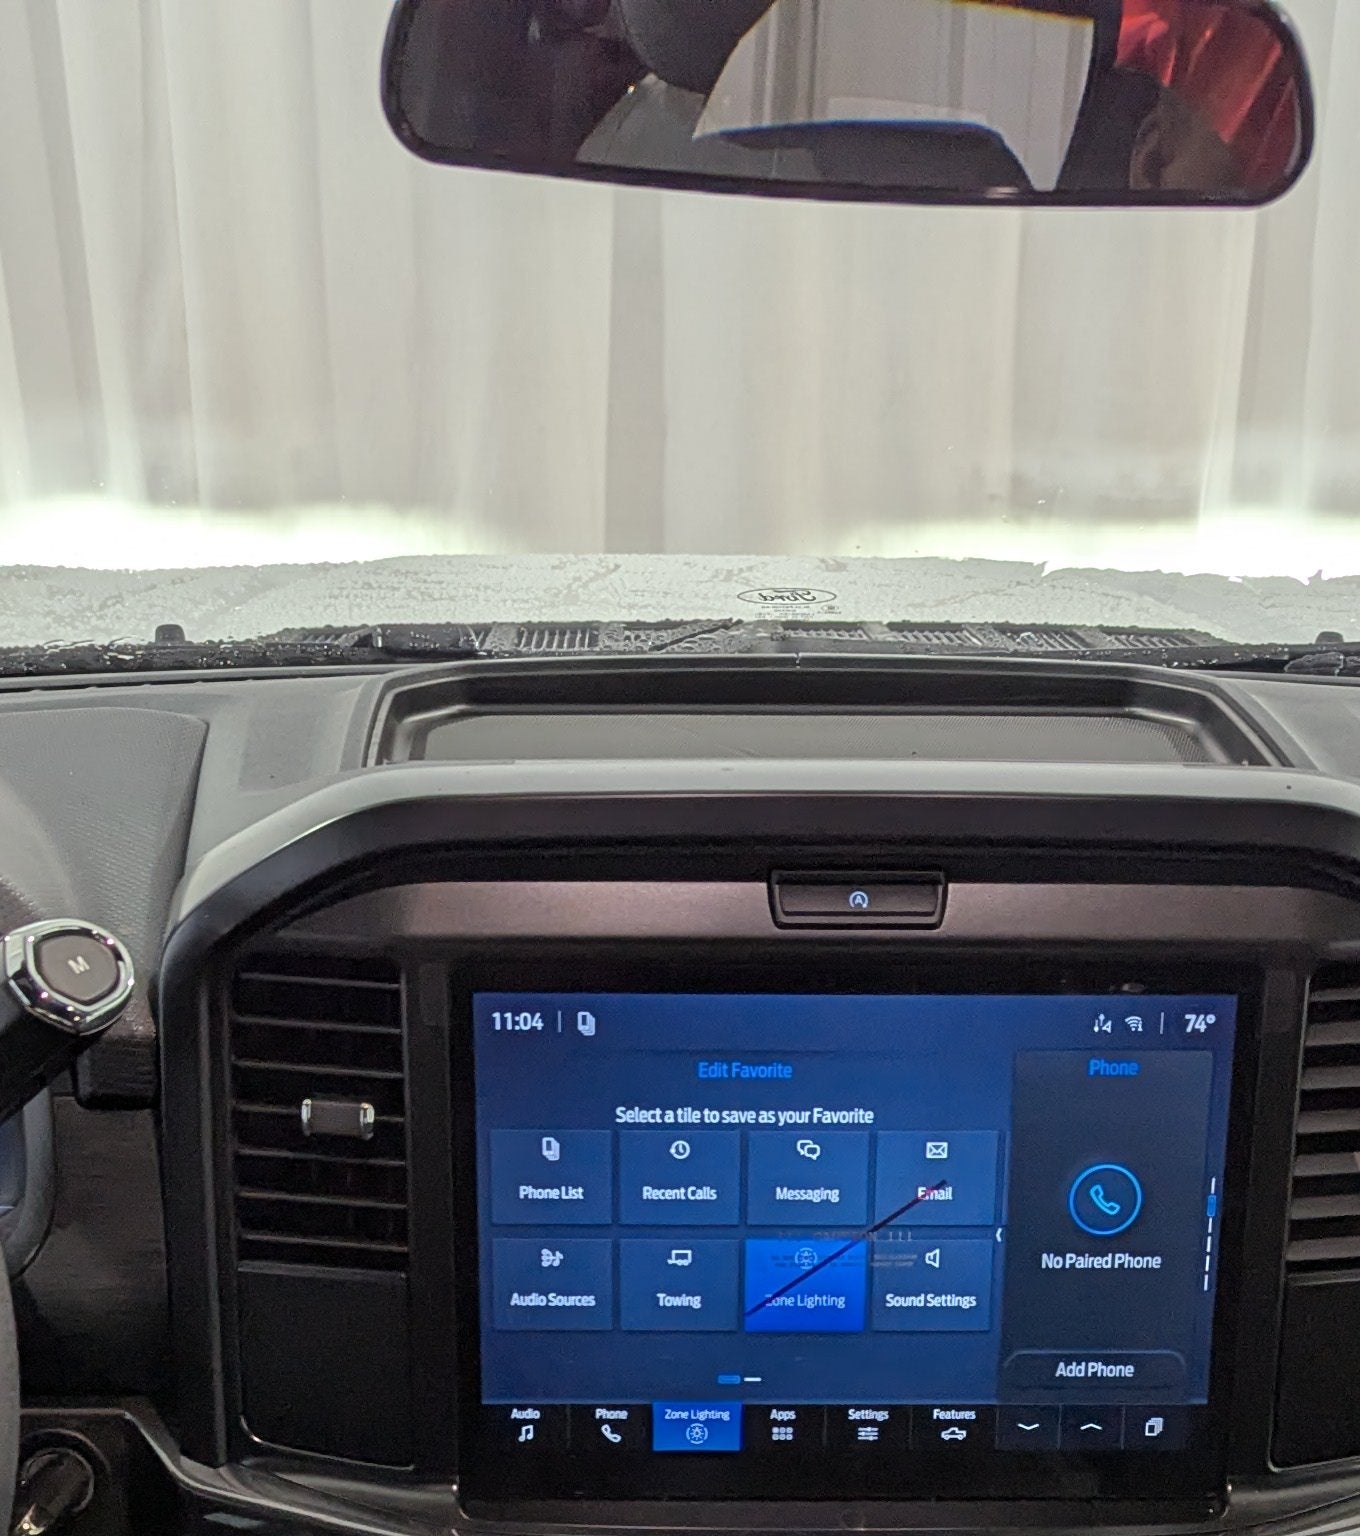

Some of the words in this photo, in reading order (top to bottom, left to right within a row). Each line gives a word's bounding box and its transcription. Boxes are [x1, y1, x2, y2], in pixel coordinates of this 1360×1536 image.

[67, 955, 90, 974] M
[491, 1012, 544, 1031] 11:04
[698, 1062, 729, 1078] Edit
[731, 1062, 793, 1078] Favorite
[1089, 1059, 1139, 1076] Phone
[615, 1107, 662, 1124] Select
[664, 1111, 674, 1123] a
[676, 1107, 701, 1124] tile
[703, 1109, 720, 1124] to
[722, 1111, 757, 1124] save
[758, 1111, 776, 1124] as
[778, 1111, 811, 1127] your
[813, 1107, 874, 1124] Favorite
[519, 1186, 560, 1200] Phone
[561, 1186, 584, 1200] List
[642, 1186, 686, 1200] Recent
[687, 1186, 717, 1200] Calls
[775, 1186, 840, 1203] Messaging
[917, 1186, 952, 1200] Email
[1041, 1254, 1063, 1269] No
[1065, 1253, 1112, 1269] Paired
[1114, 1253, 1162, 1269] Phone
[510, 1293, 547, 1307] Audio
[548, 1293, 596, 1307] Sources
[656, 1293, 701, 1309] Towing
[765, 1294, 795, 1307] Zone
[797, 1293, 846, 1309] Lighting
[885, 1294, 925, 1307] Sound
[926, 1294, 977, 1309] Settings
[1055, 1362, 1085, 1378] Add
[1087, 1362, 1135, 1378] Phone
[511, 1408, 540, 1420] Audio
[595, 1408, 628, 1420] Phone
[664, 1408, 689, 1420] Zone
[690, 1408, 730, 1422] Lighting
[770, 1408, 796, 1422] Apps
[848, 1408, 890, 1421] Settings
[933, 1408, 976, 1420] Features
